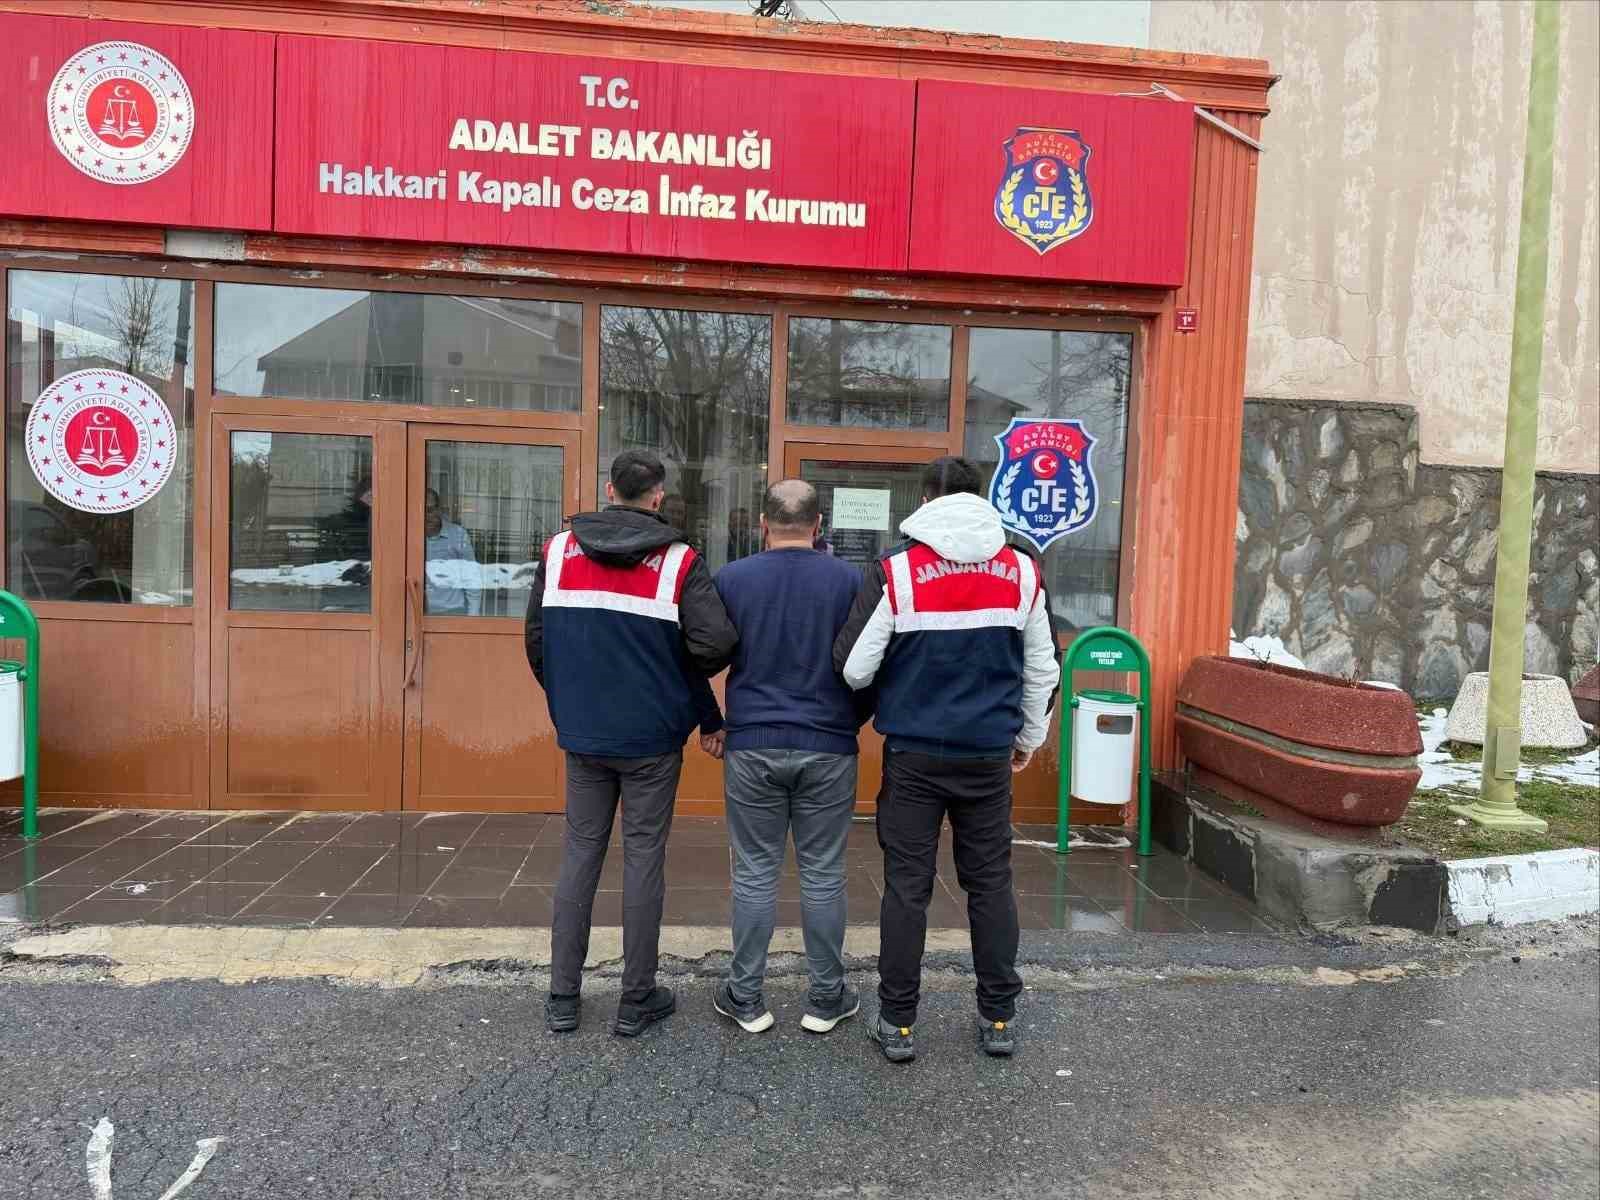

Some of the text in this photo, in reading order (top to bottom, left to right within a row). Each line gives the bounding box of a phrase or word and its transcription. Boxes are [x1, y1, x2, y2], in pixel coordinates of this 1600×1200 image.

[579, 75, 640, 110] T.C.
[449, 118, 772, 170] ADALET BAKANLIĞI
[318, 162, 867, 228] Hakkari Kapalı Ceza İnfaz Kurumu
[1023, 186, 1067, 219] CTE
[1035, 221, 1054, 230] 1923
[1022, 480, 1068, 512] CTE
[1035, 514, 1054, 523] 1923
[915, 559, 1018, 585] JANDARMA
